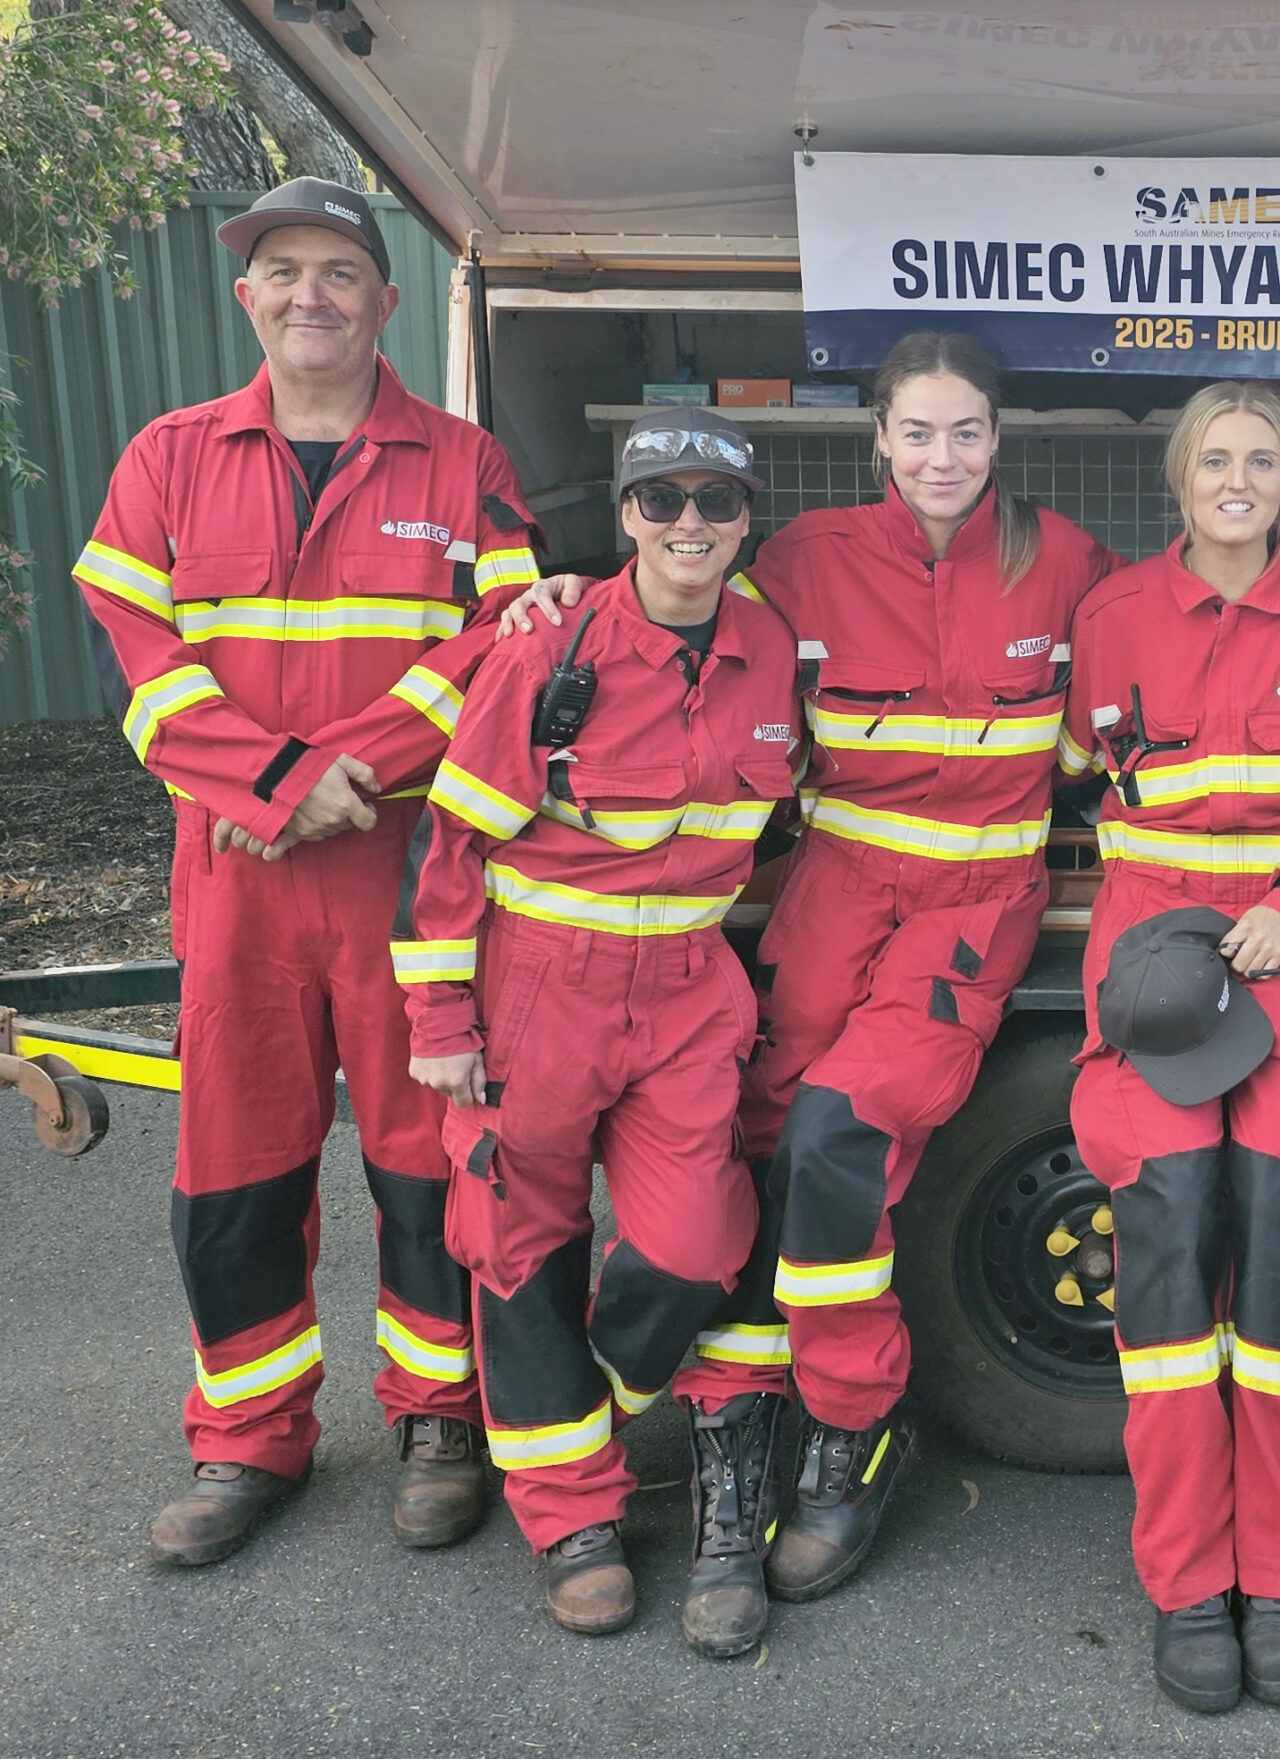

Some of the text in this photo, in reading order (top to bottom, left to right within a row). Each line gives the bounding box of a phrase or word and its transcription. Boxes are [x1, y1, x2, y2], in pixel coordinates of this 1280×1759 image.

[1134, 229, 1157, 237] South
[1160, 229, 1199, 237] Australian
[1201, 229, 1225, 238] Mines
[1227, 230, 1270, 239] Emergency
[892, 239, 1085, 303] SIMEC
[1115, 317, 1194, 350] 2025
[399, 523, 448, 543] SIMEC
[1020, 636, 1050, 655] SIMEC
